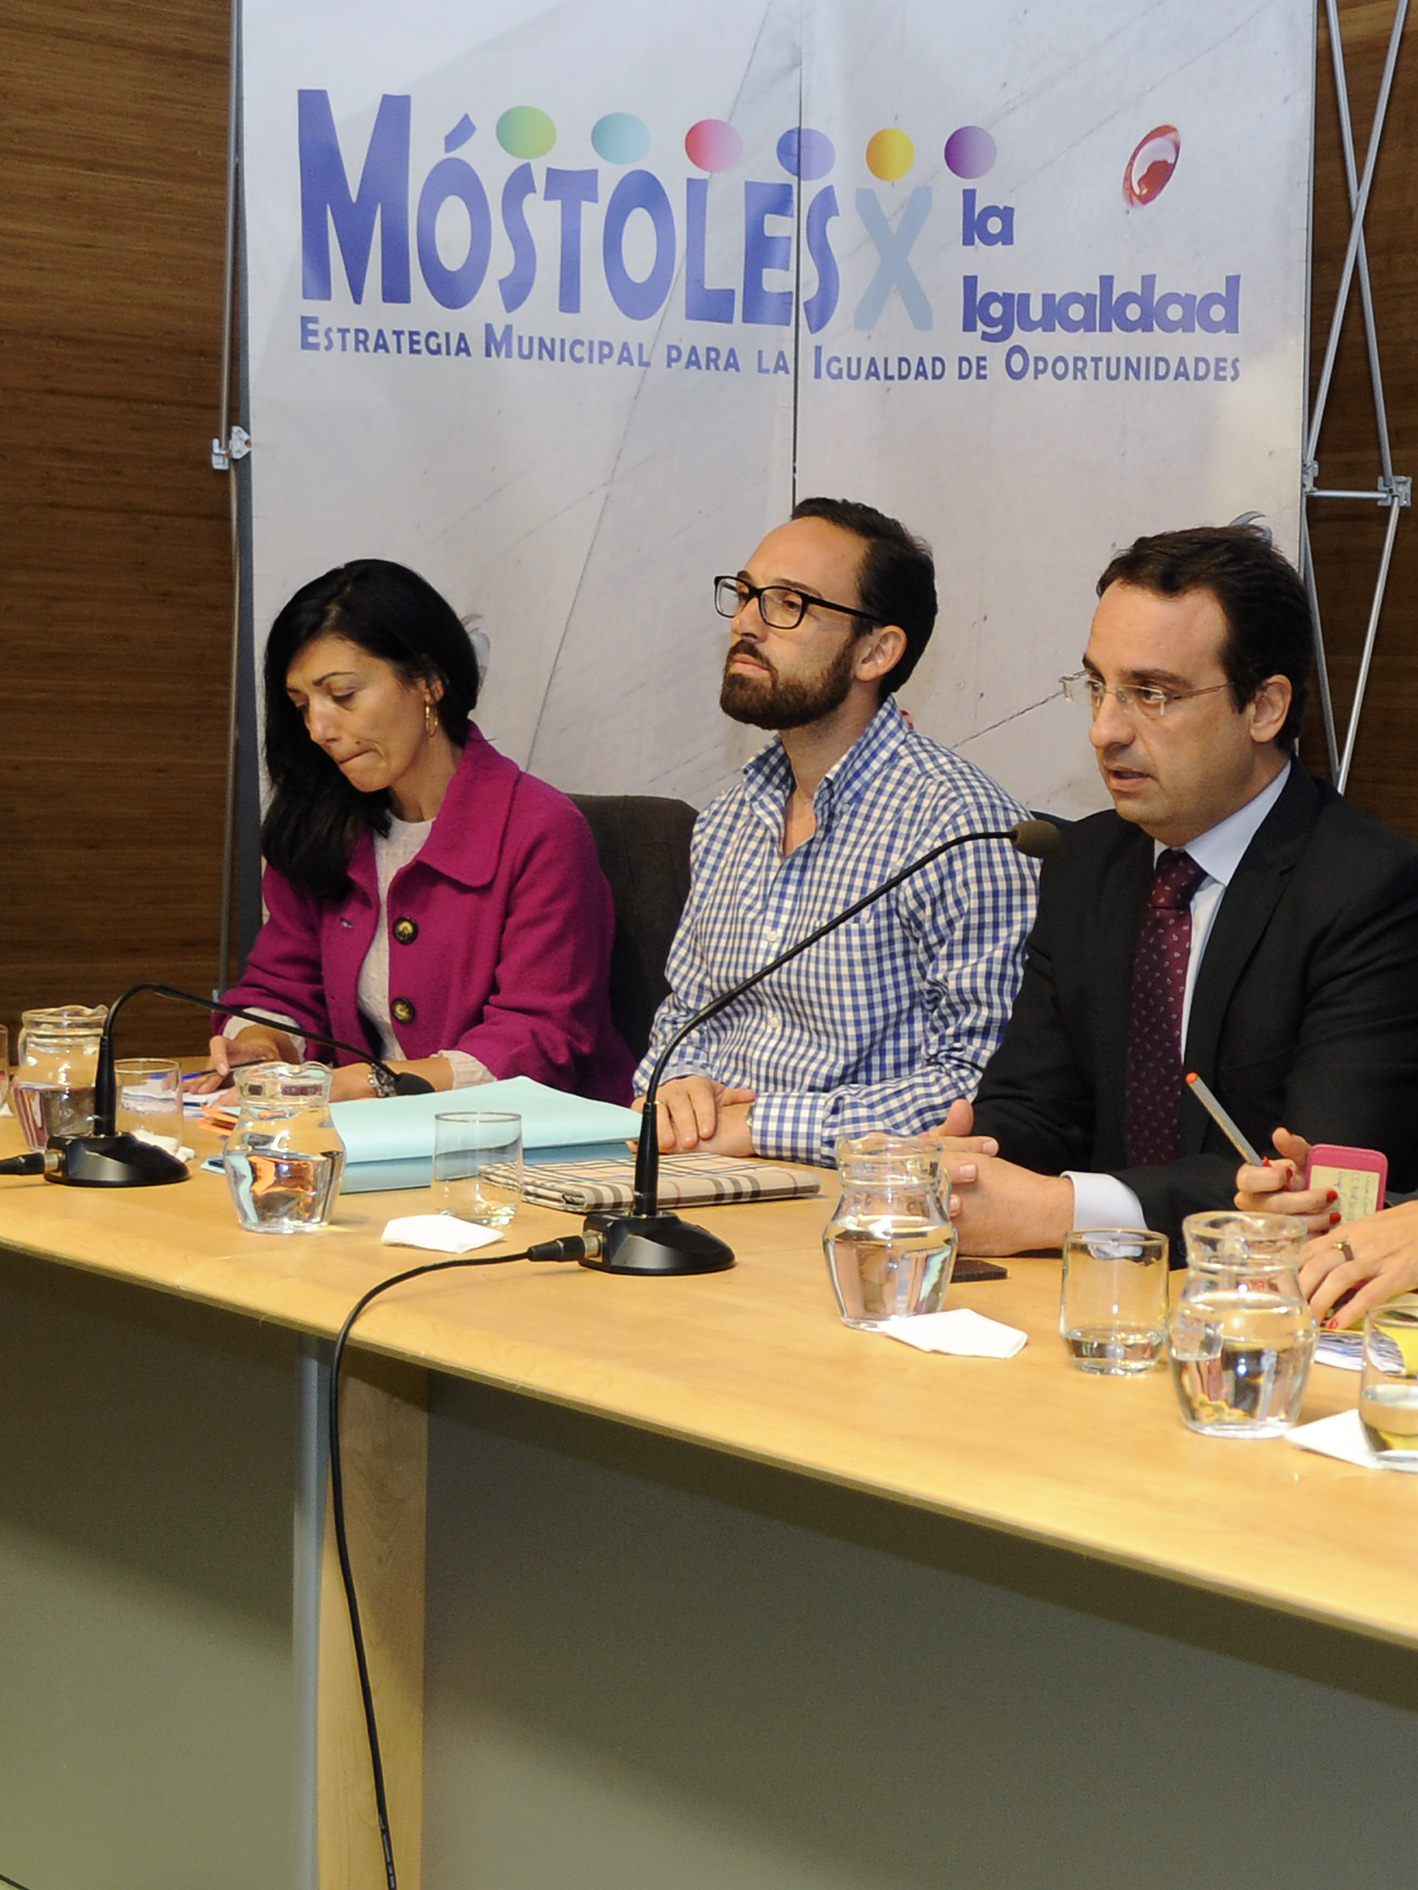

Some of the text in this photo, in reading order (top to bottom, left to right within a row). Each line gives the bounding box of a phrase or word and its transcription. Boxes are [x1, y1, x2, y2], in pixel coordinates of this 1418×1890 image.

[297, 88, 1015, 335] MÓSTOLES X la
[961, 273, 1241, 343] Igualdad
[299, 315, 1241, 383] ESTRATEGIA MUNICIPAL PARA LA IGUALDAD DE OPORTUNIDADES
